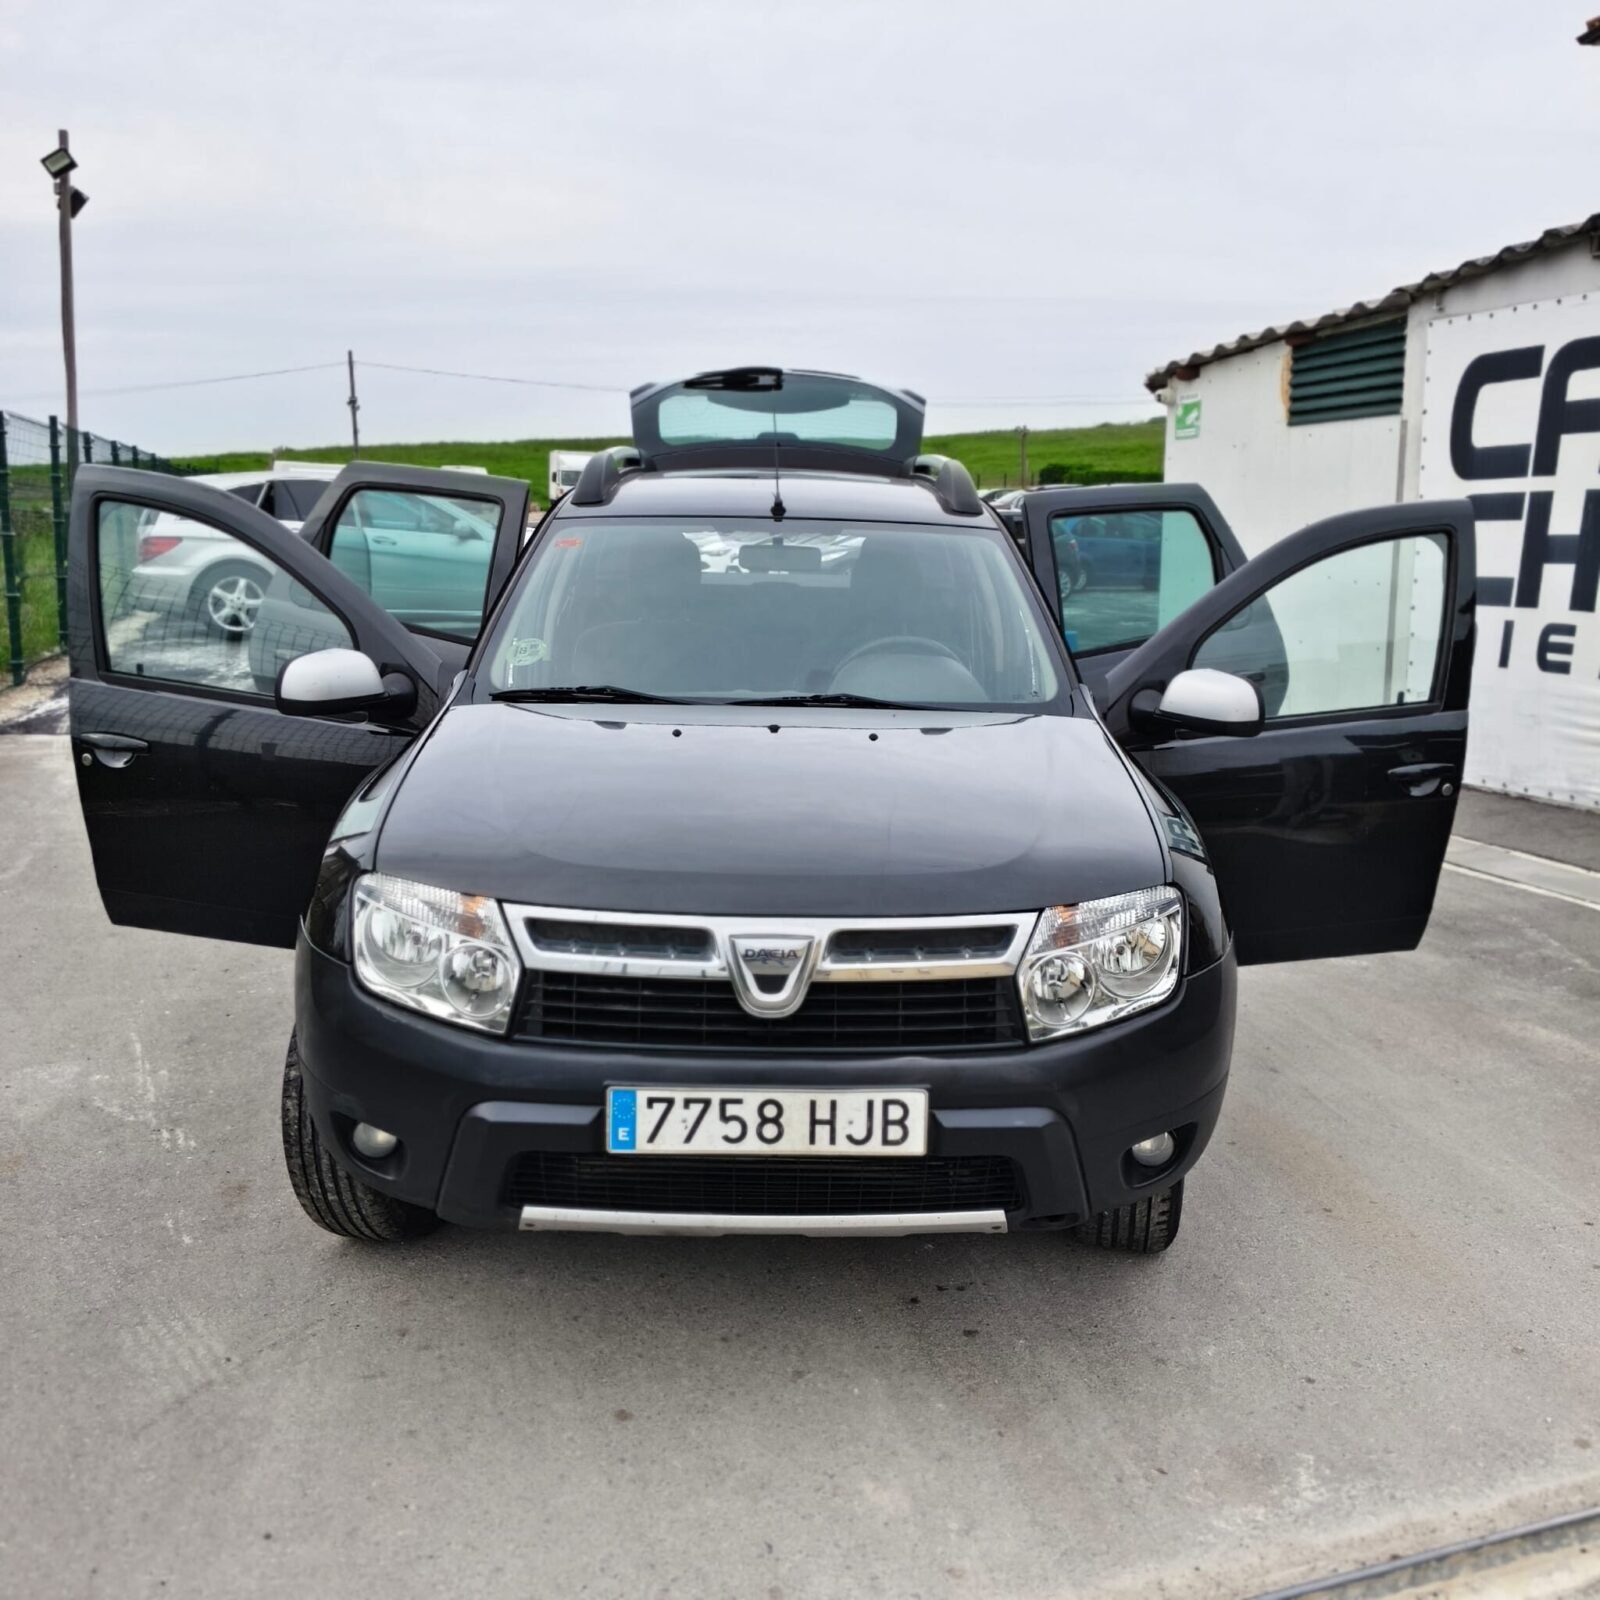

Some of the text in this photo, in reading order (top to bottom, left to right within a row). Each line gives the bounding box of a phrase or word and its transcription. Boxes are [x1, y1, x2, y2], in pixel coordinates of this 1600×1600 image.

[744, 948, 798, 959] DACIA
[646, 1096, 910, 1147] 7758 HJB
[618, 1127, 630, 1141] E
